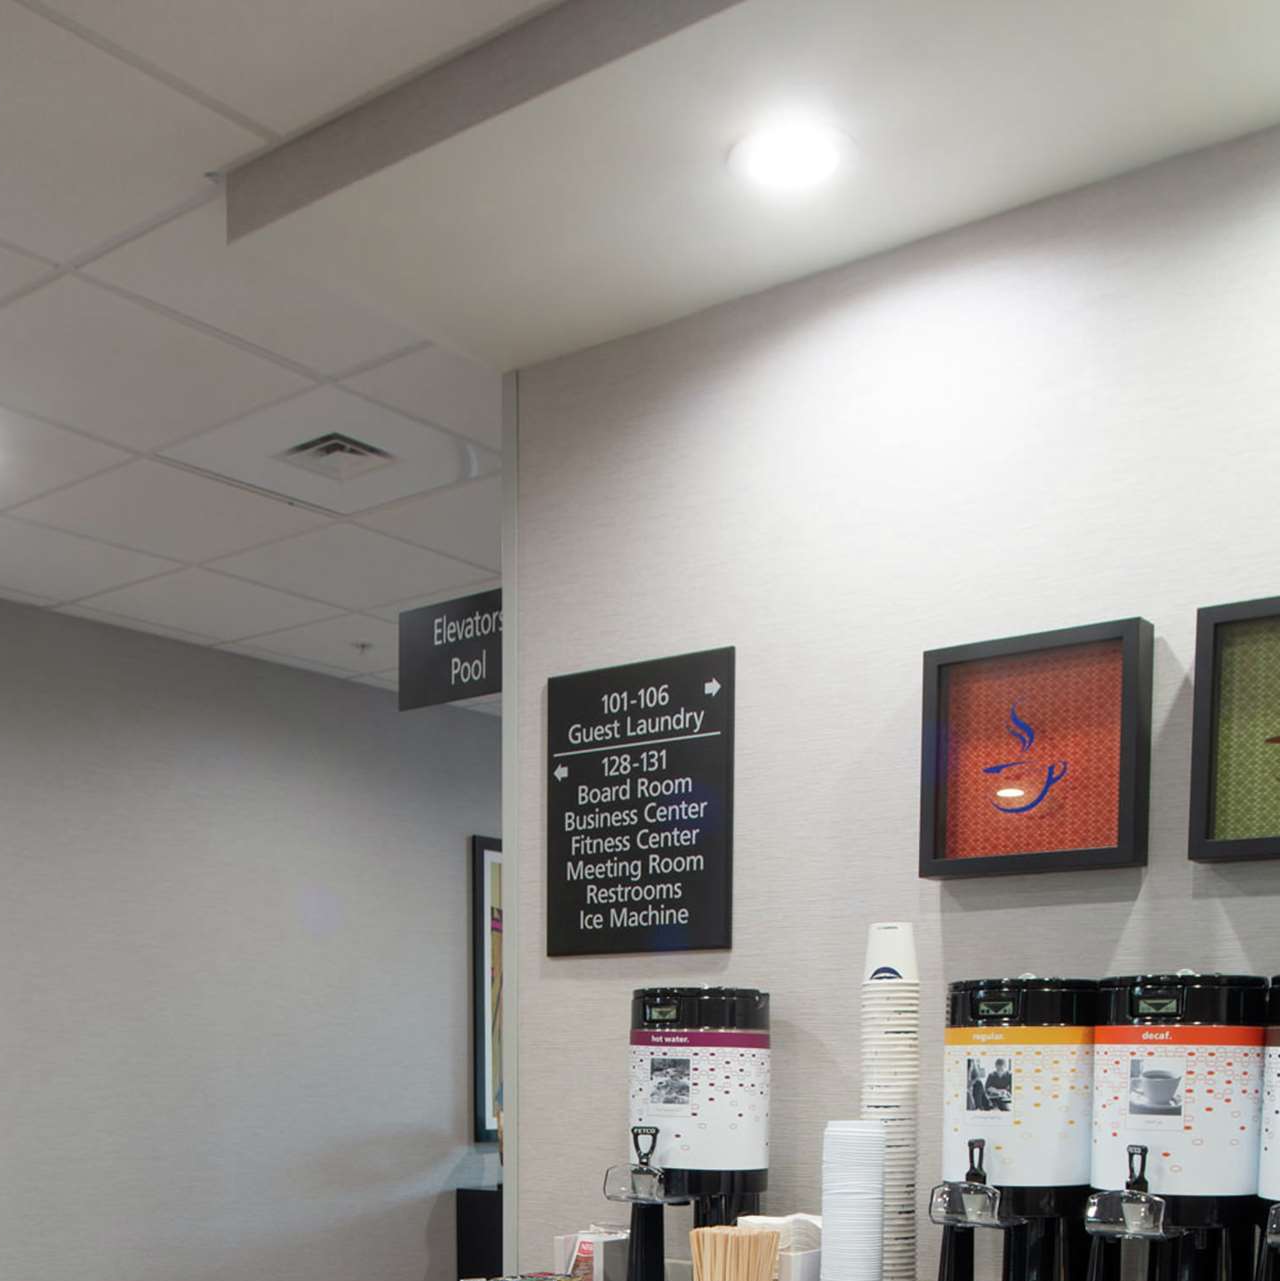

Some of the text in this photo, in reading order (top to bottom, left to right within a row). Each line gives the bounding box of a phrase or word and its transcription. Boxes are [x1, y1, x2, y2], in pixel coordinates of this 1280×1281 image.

[451, 649, 486, 685] Pool
[601, 684, 670, 714] 101-106
[568, 707, 705, 744] Guest Laundry
[601, 750, 667, 777] 128-131
[578, 776, 693, 805] Board Room
[565, 800, 708, 832] Business Center
[571, 827, 700, 856] Fitness Center
[566, 854, 704, 881] Meeting Room
[586, 882, 682, 904] Restrooms
[580, 904, 689, 930] Ice Machine
